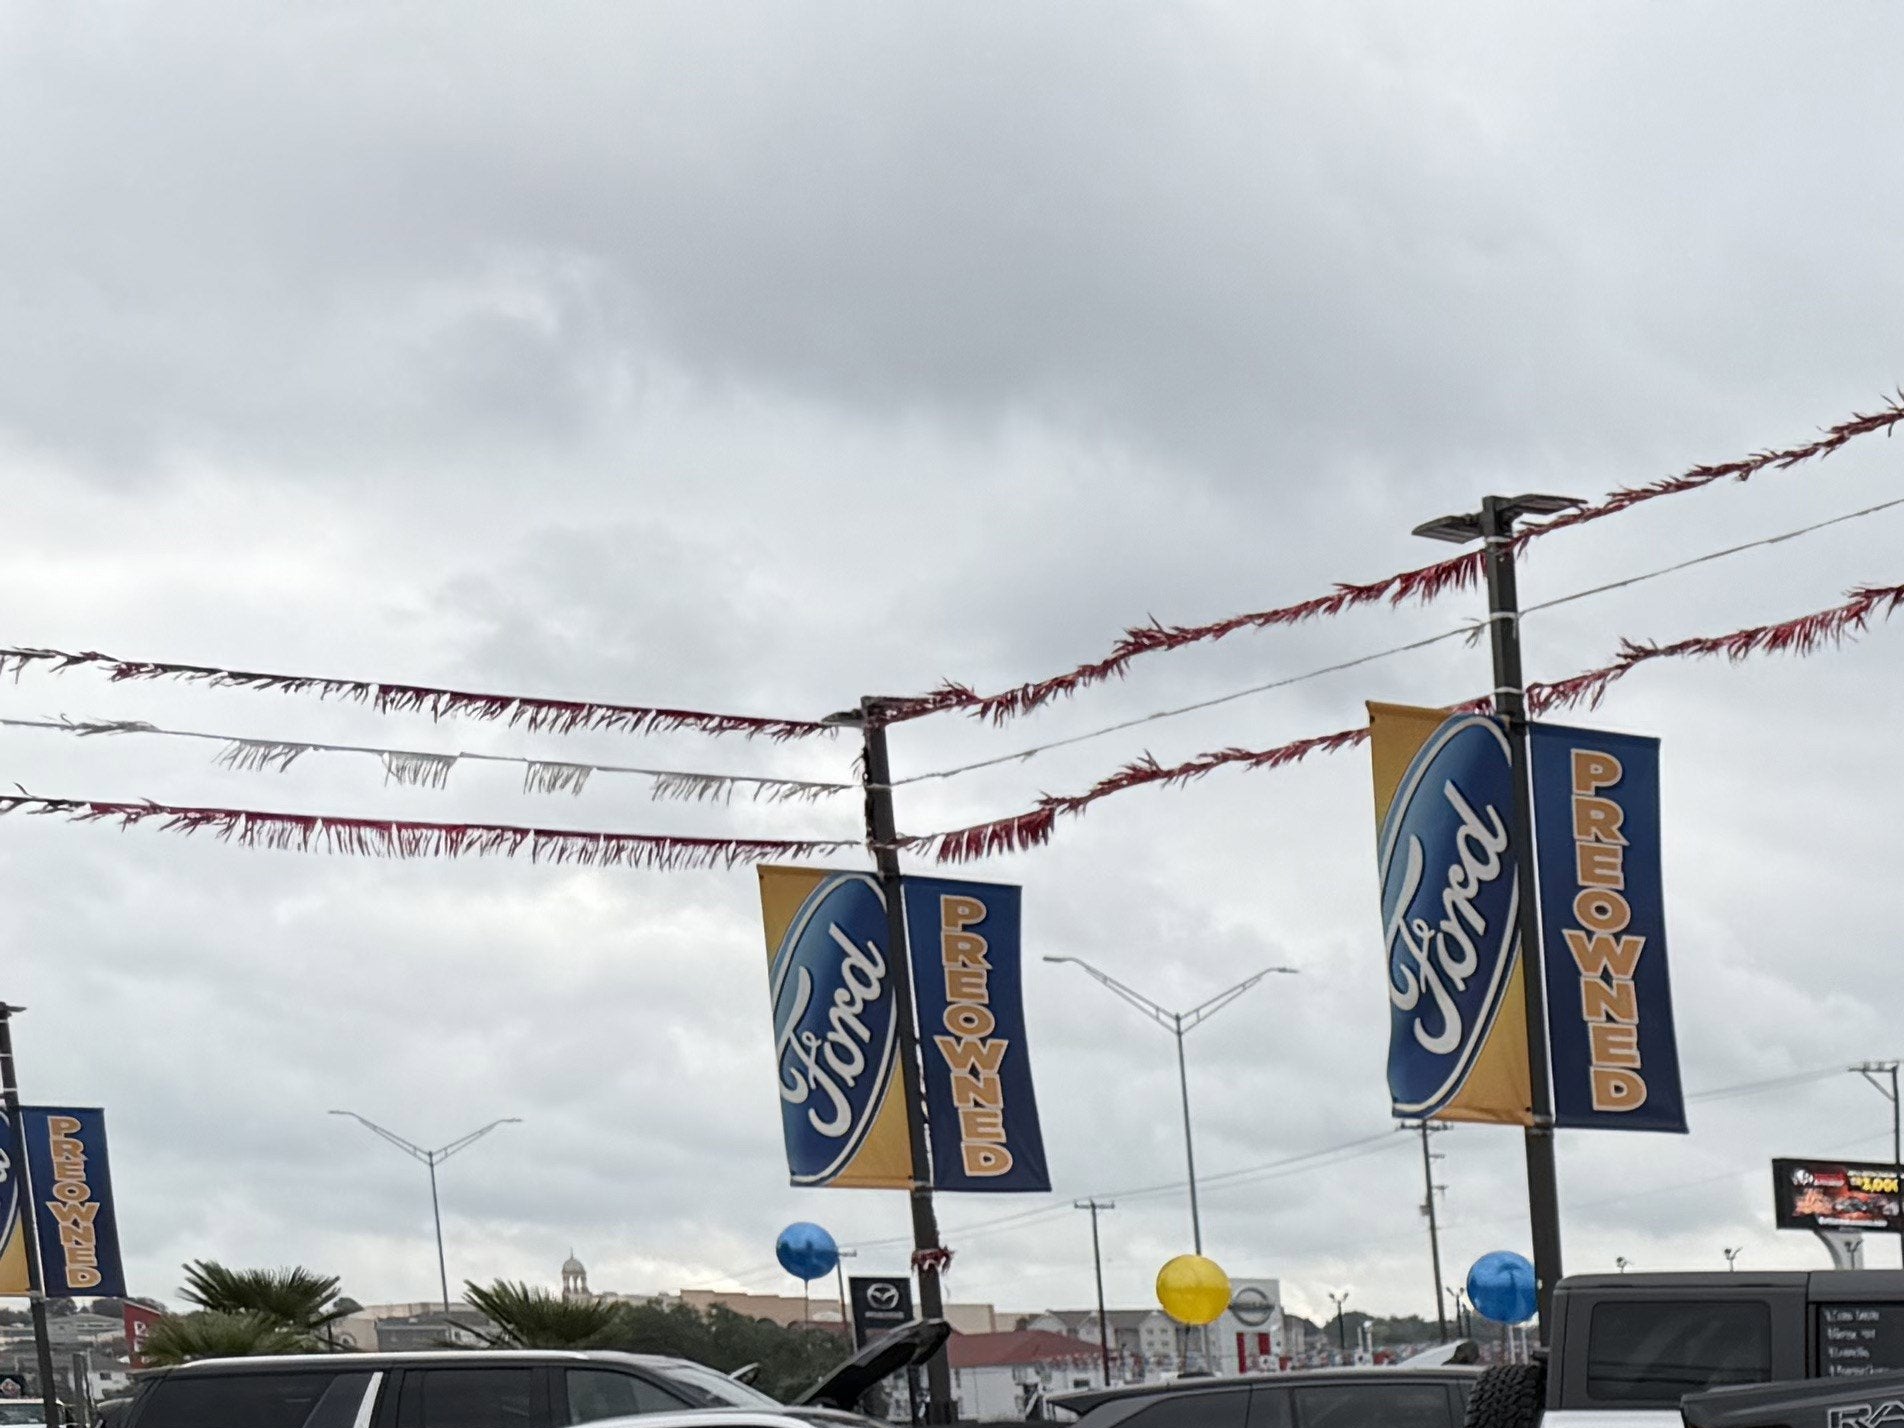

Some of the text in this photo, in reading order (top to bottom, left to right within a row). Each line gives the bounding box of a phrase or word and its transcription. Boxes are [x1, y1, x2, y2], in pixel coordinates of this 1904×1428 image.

[777, 922, 886, 1138] Ford
[933, 894, 1013, 1177] PREOWNED
[1387, 779, 1508, 1055] Ford
[1562, 748, 1647, 1112] PREOWNED
[46, 1116, 101, 1288] PREOWNED
